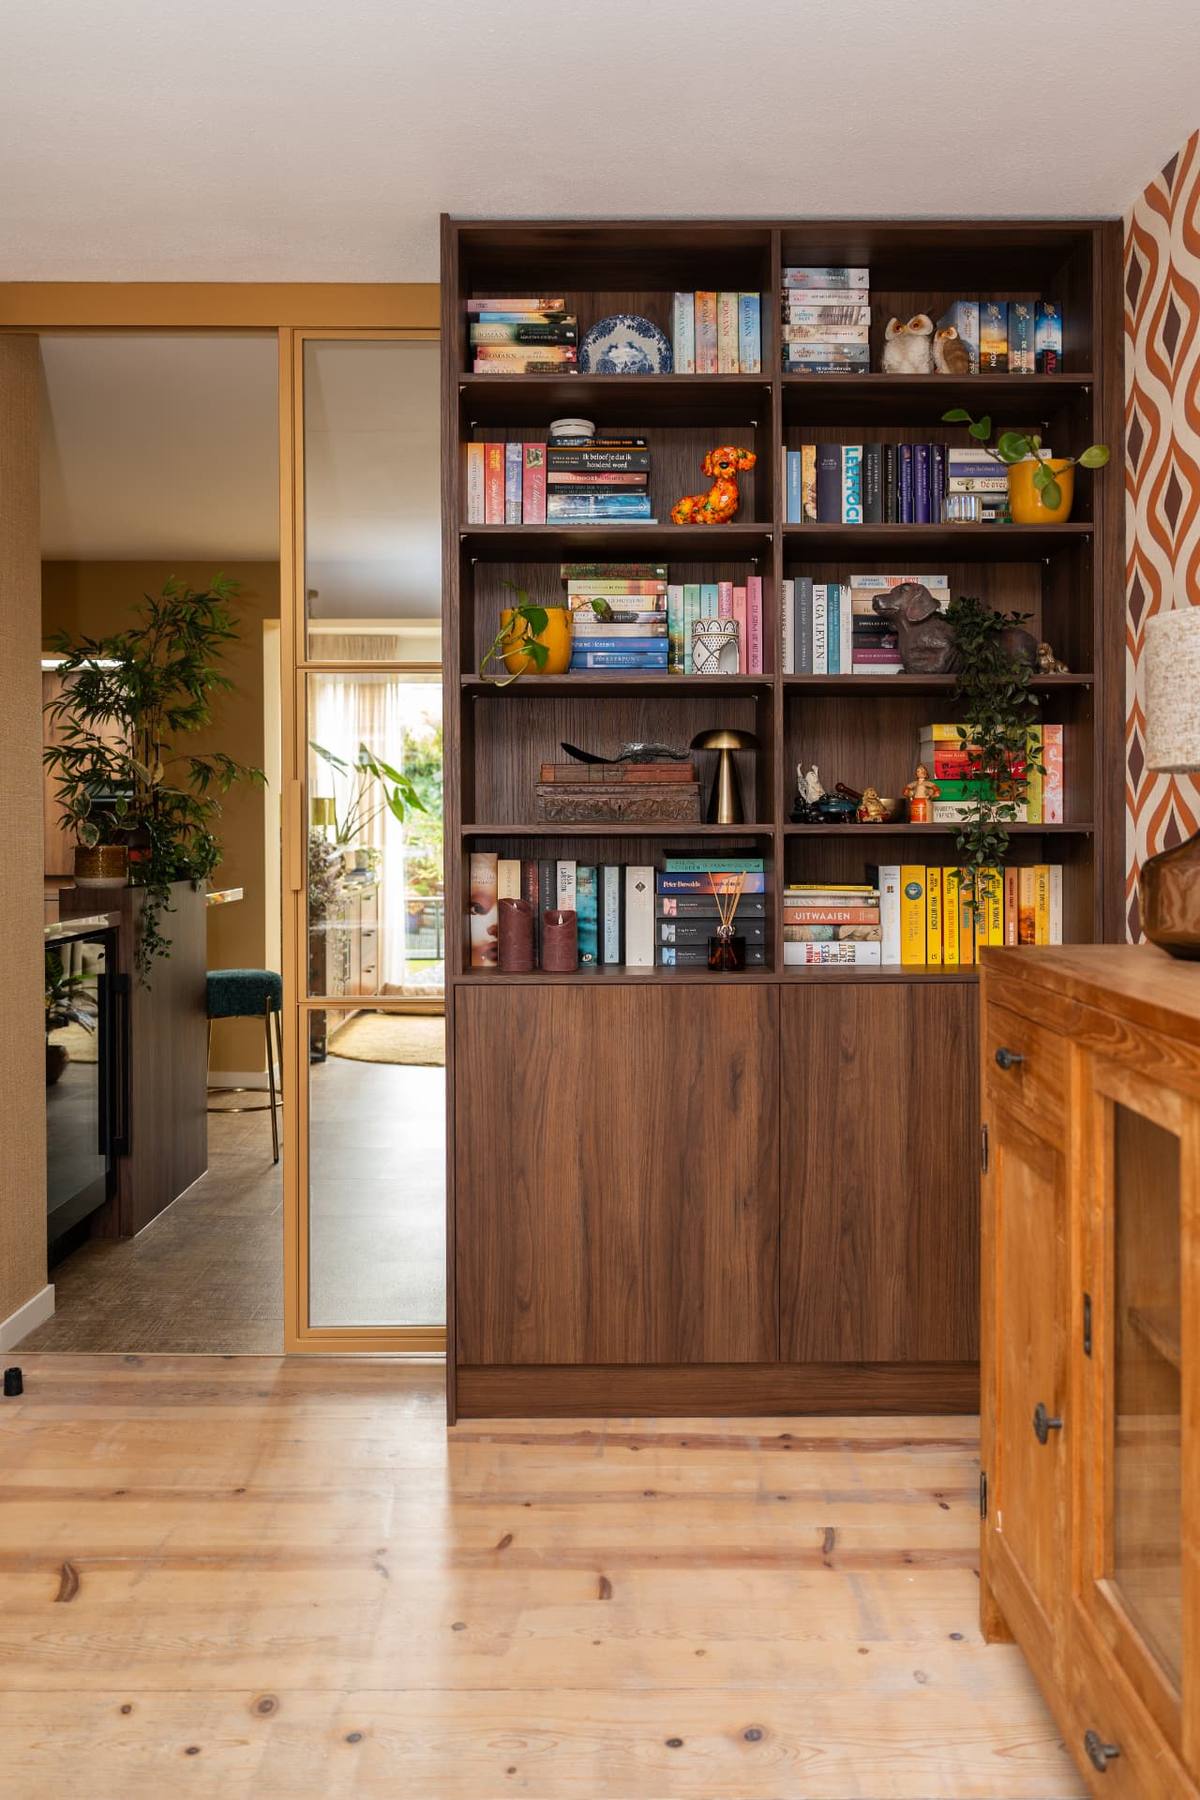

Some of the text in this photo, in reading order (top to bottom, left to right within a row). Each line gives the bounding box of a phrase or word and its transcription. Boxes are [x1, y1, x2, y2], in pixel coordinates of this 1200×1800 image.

[590, 453, 609, 461] beloof
[815, 589, 825, 659] IK GA LEVEN
[796, 912, 851, 921] UITWAAIEN
